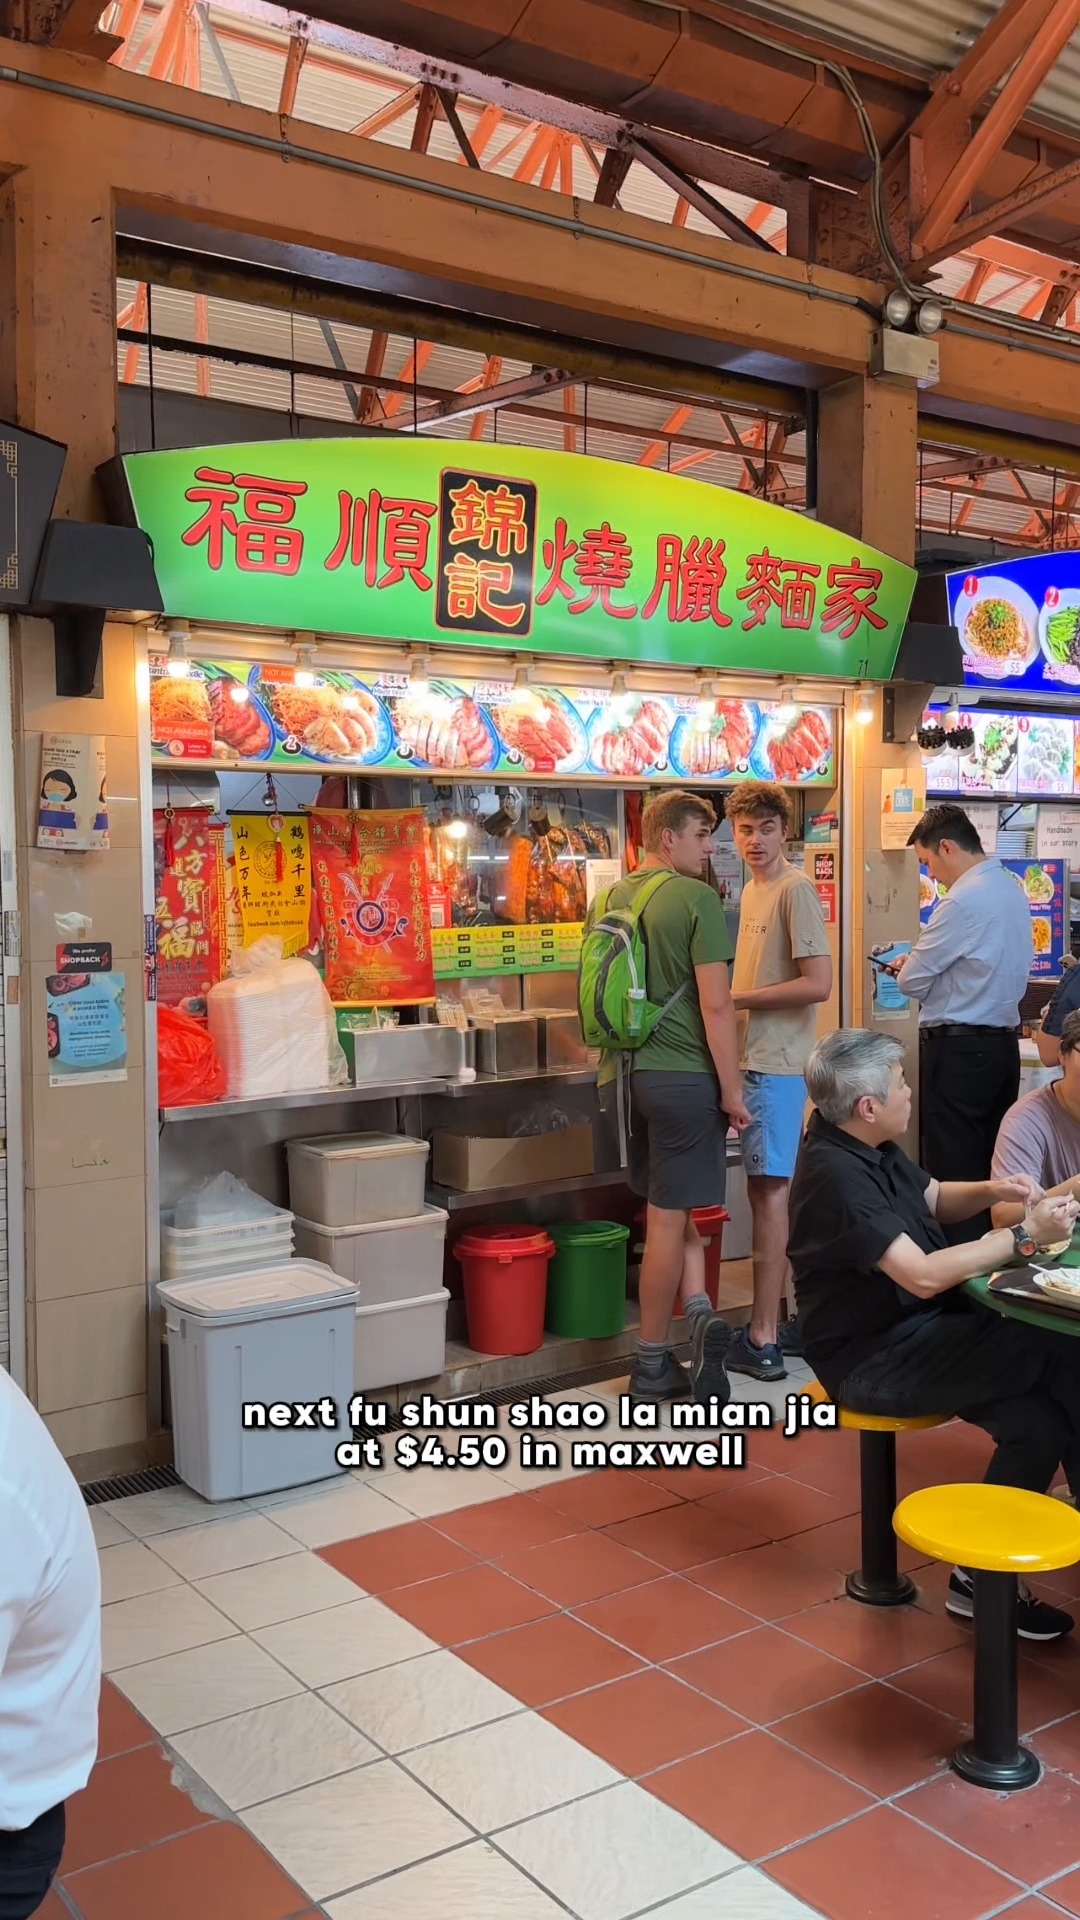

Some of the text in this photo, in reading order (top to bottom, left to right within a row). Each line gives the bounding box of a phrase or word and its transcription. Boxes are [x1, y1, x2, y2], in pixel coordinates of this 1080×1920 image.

[182, 466, 438, 592] 福順
[444, 478, 529, 628] 錦記
[287, 736, 296, 749] 2
[816, 867, 833, 875] BACK
[60, 956, 101, 964] SHOPBACK
